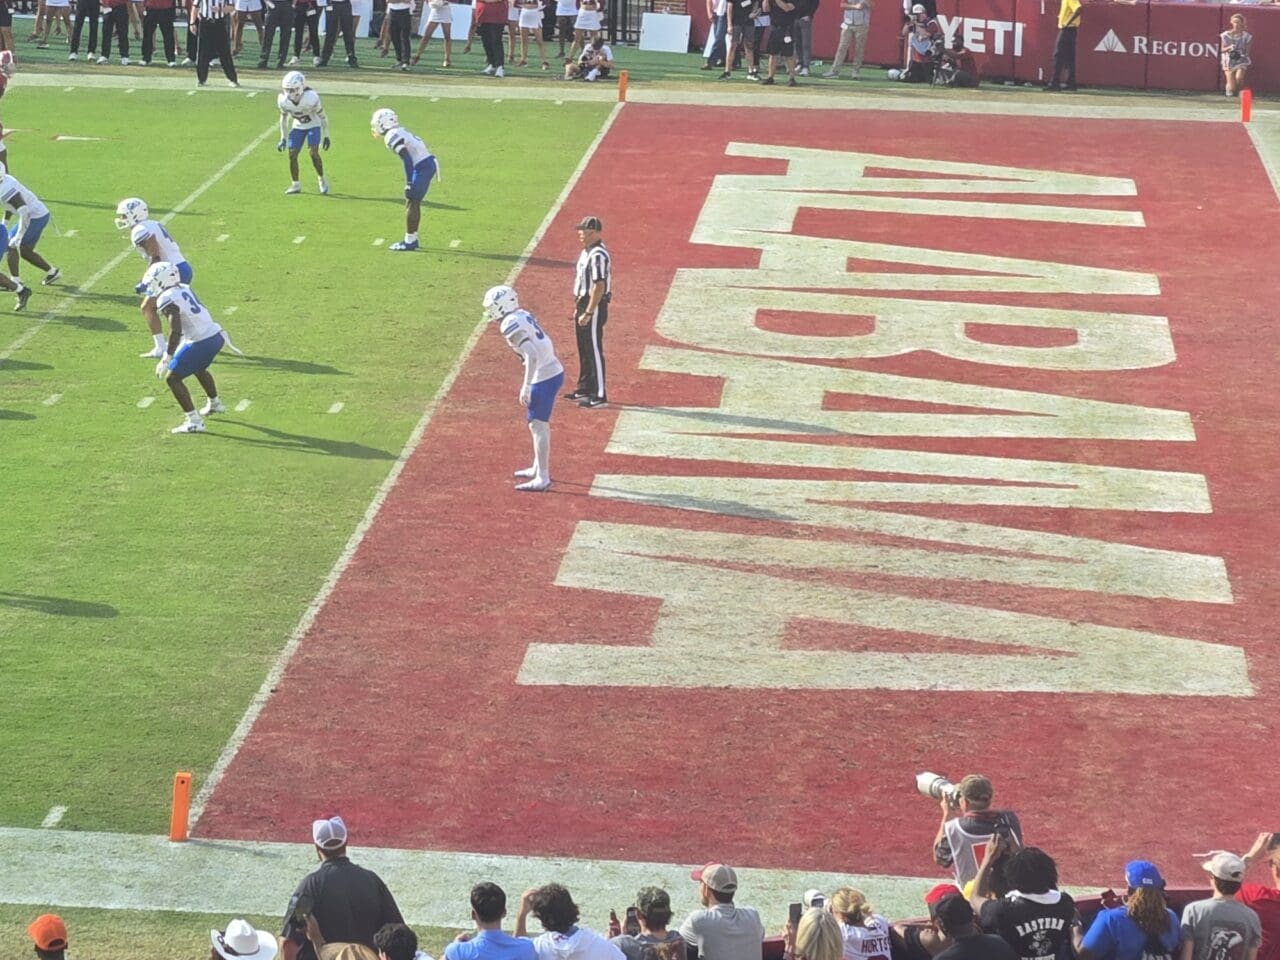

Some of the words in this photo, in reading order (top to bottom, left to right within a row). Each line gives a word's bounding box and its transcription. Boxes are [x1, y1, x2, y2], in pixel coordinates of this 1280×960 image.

[936, 14, 1026, 57] YETI
[1133, 35, 1220, 58] REGION
[516, 141, 1257, 697] ALABAMA
[1016, 917, 1065, 937] EASTERN
